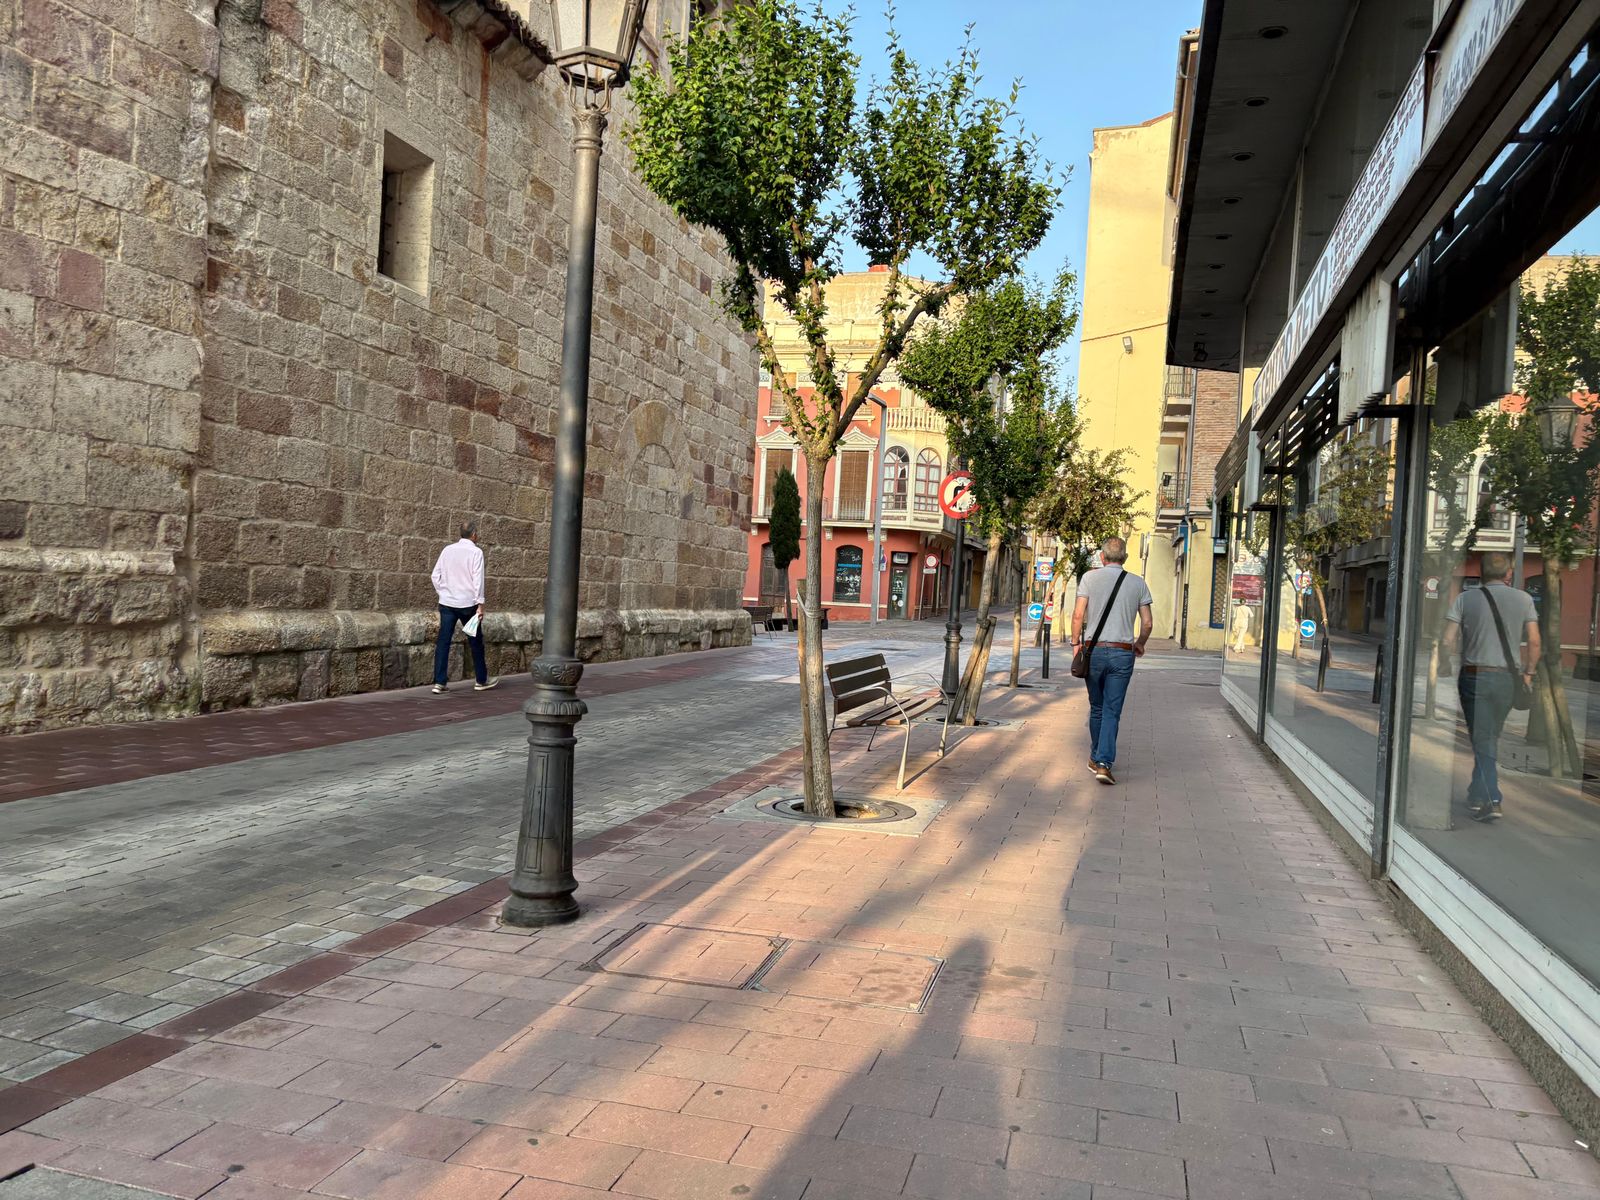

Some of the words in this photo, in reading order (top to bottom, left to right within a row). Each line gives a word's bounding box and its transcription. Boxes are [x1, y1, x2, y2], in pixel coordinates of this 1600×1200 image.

[1370, 145, 1383, 173] DE
[1260, 322, 1293, 408] CENTRO
[1293, 255, 1329, 358] RETO
